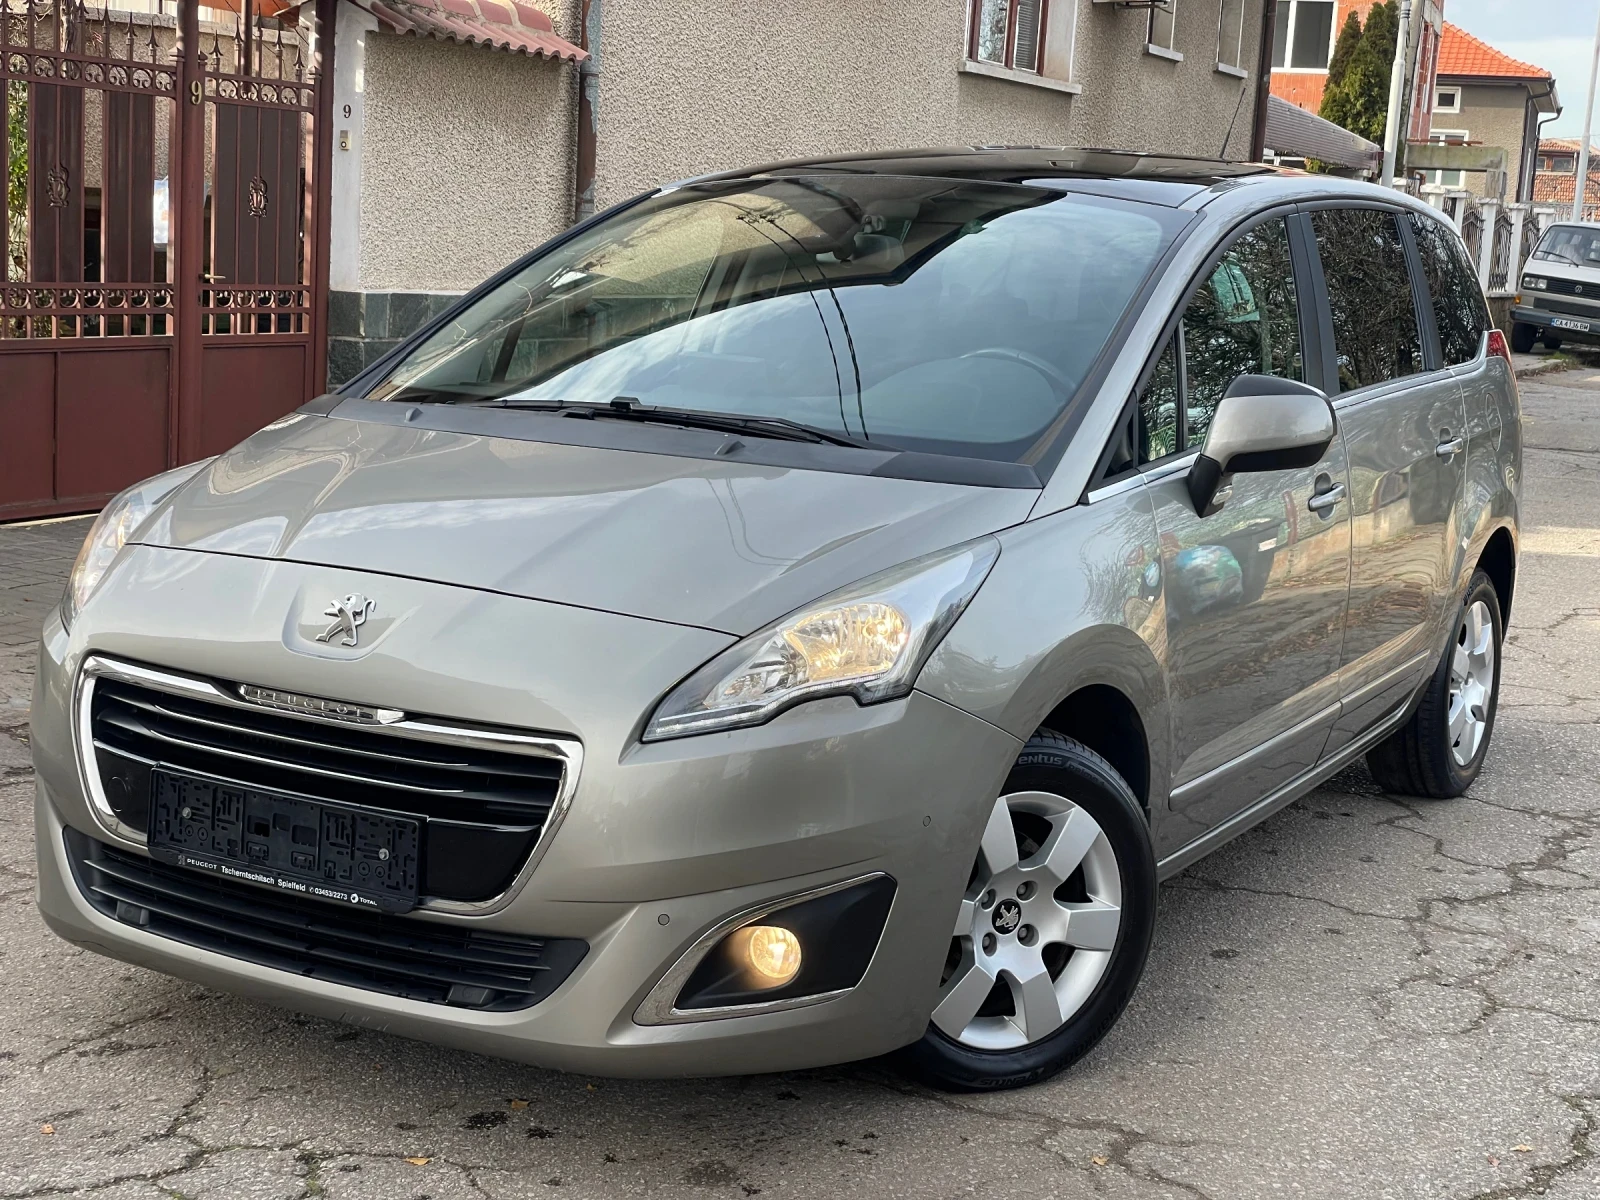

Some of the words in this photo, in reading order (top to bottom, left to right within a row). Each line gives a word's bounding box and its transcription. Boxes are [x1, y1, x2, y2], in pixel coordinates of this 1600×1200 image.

[191, 80, 202, 105] 9
[343, 104, 351, 118] 9
[257, 689, 364, 717] PEUGEOT
[187, 858, 217, 869] PEUGEOT
[277, 878, 306, 892] Spielfeld
[314, 887, 348, 900] 03453/2273
